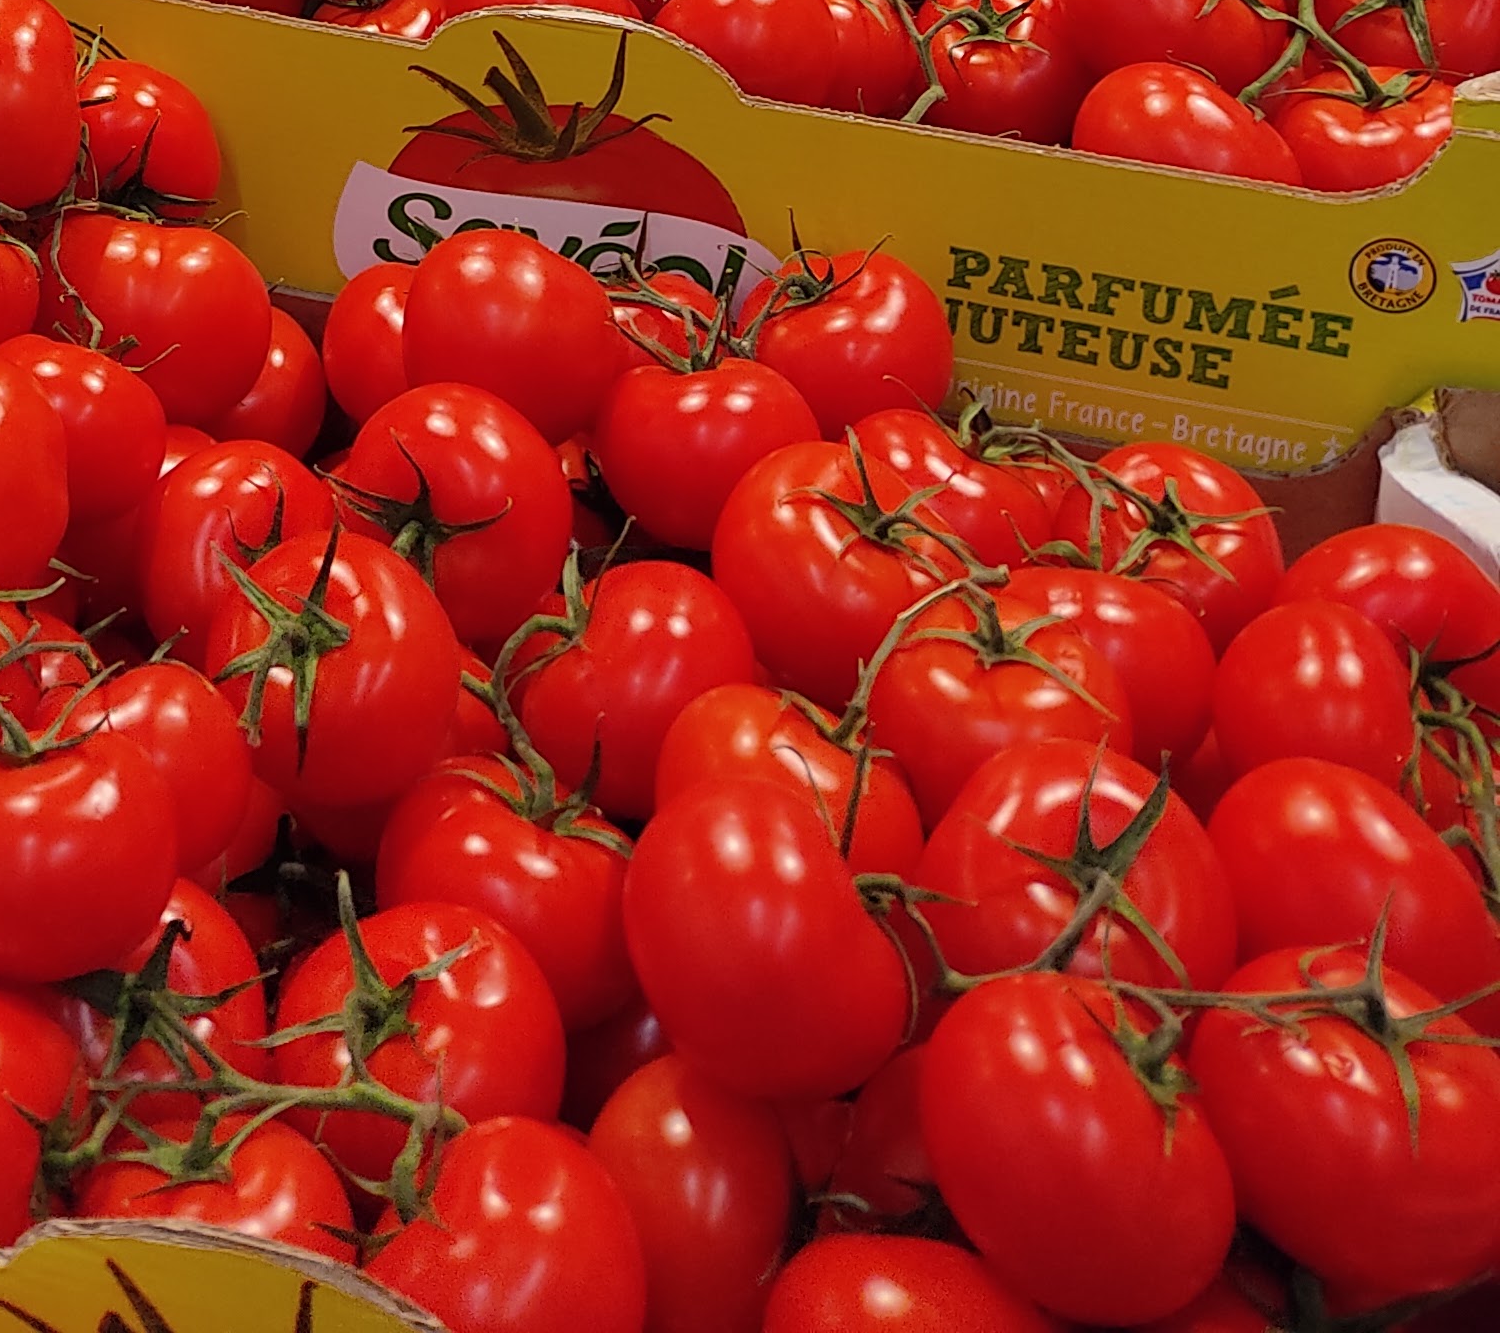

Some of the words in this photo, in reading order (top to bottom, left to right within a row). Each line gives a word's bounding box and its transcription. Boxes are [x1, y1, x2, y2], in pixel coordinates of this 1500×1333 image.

[1364, 242, 1413, 259] PRODUIT
[947, 245, 1354, 358] PARFUMÉE
[1358, 281, 1424, 309] BRETAGNE
[1472, 293, 1500, 304] TOMA
[1470, 304, 1481, 312] DE
[952, 376, 1038, 414] rigine
[1048, 390, 1146, 434] France
[1171, 414, 1308, 465] Bretagne
